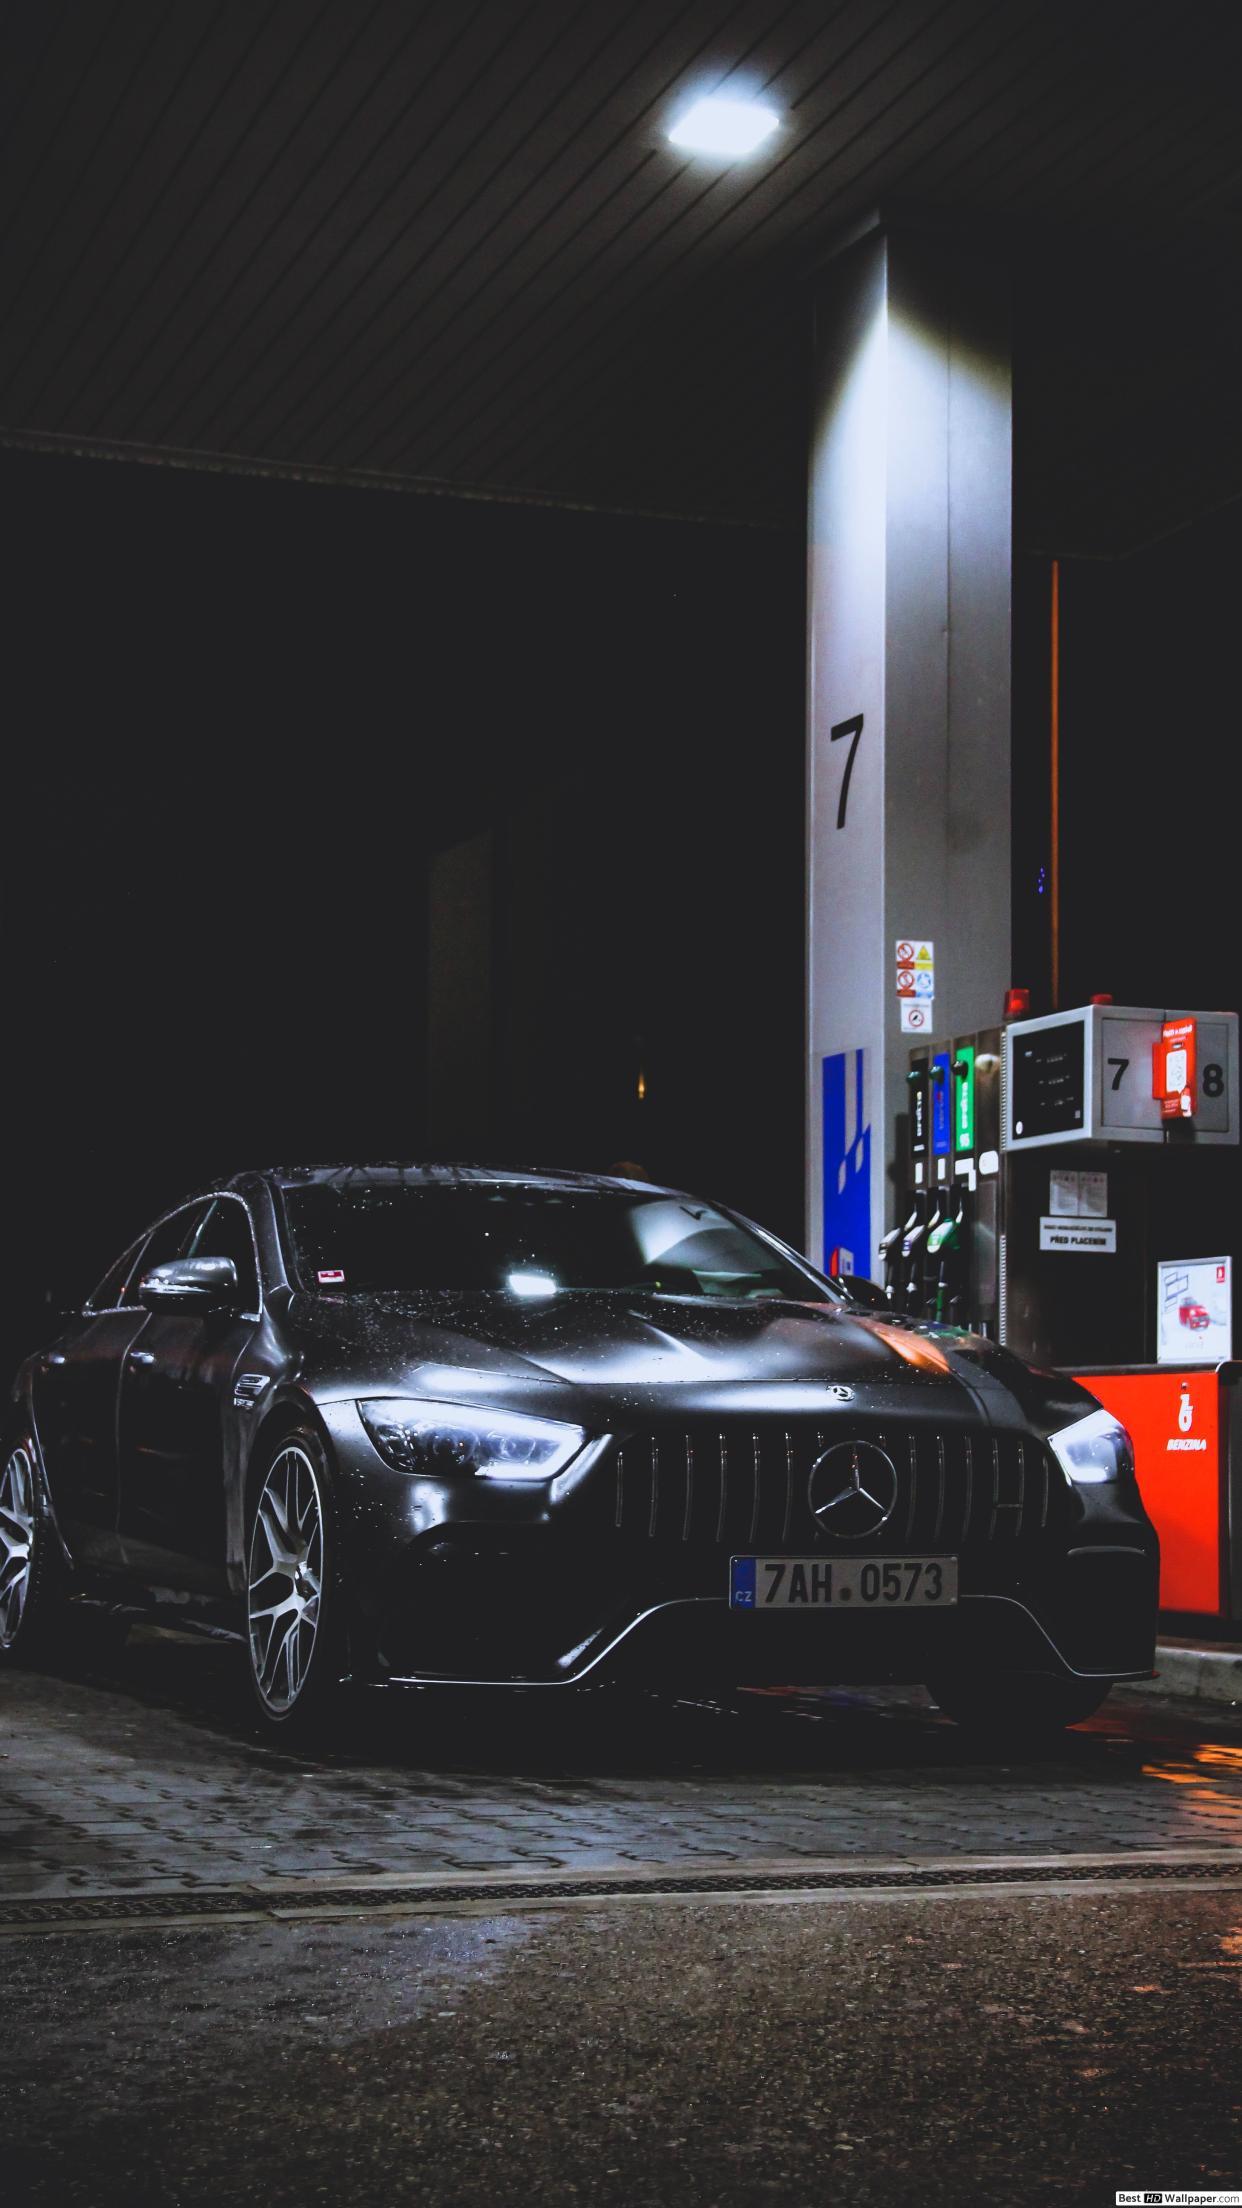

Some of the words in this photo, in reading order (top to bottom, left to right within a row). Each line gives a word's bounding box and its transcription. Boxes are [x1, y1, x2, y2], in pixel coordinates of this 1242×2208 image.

[831, 713, 864, 830] 7
[1107, 1058, 1130, 1090] 7
[1202, 1063, 1225, 1098] 8
[1166, 1438, 1207, 1451] BENZINA
[735, 1591, 752, 1602] CZ
